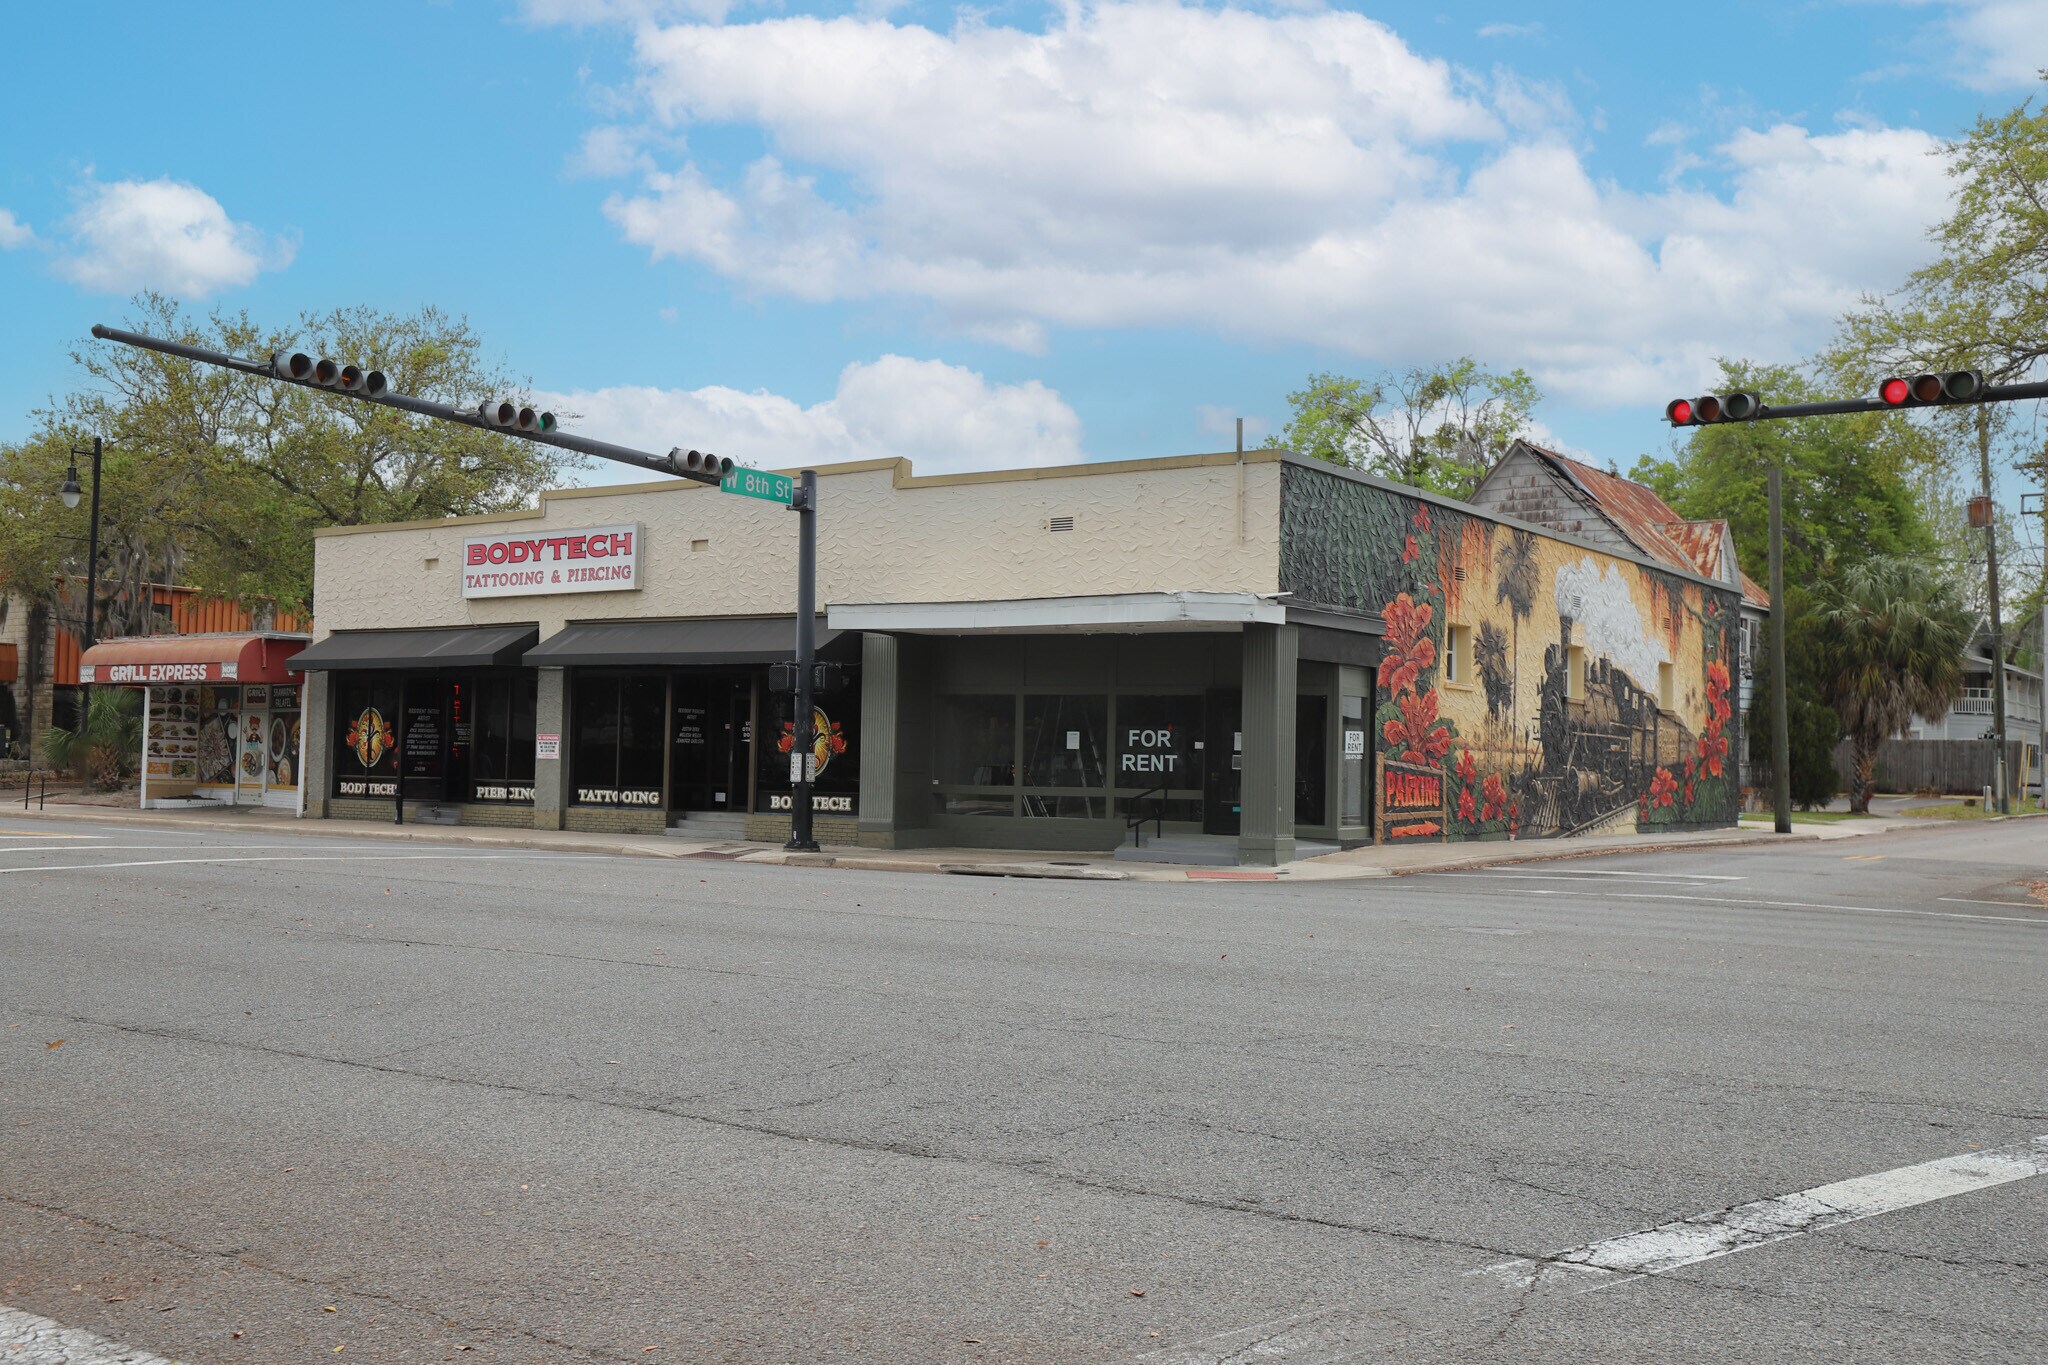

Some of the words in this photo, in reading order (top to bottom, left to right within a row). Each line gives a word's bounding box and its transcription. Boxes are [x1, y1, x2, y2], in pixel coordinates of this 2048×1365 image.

[746, 474, 769, 494] 8th
[775, 480, 789, 498] St
[467, 532, 632, 565] BODYTECH
[466, 571, 544, 588] TATTOOING
[551, 570, 561, 583] &
[567, 565, 631, 582] PIERCING
[110, 664, 147, 682] GRILL
[148, 664, 207, 680] EXPRESS
[1128, 730, 1171, 747] FOR
[1349, 733, 1360, 741] FOR
[1348, 743, 1361, 751] RENT
[1122, 754, 1178, 772] RENT
[578, 789, 660, 805] TATTOOING
[1386, 771, 1440, 807] PARKING
[812, 796, 852, 811] TECH
